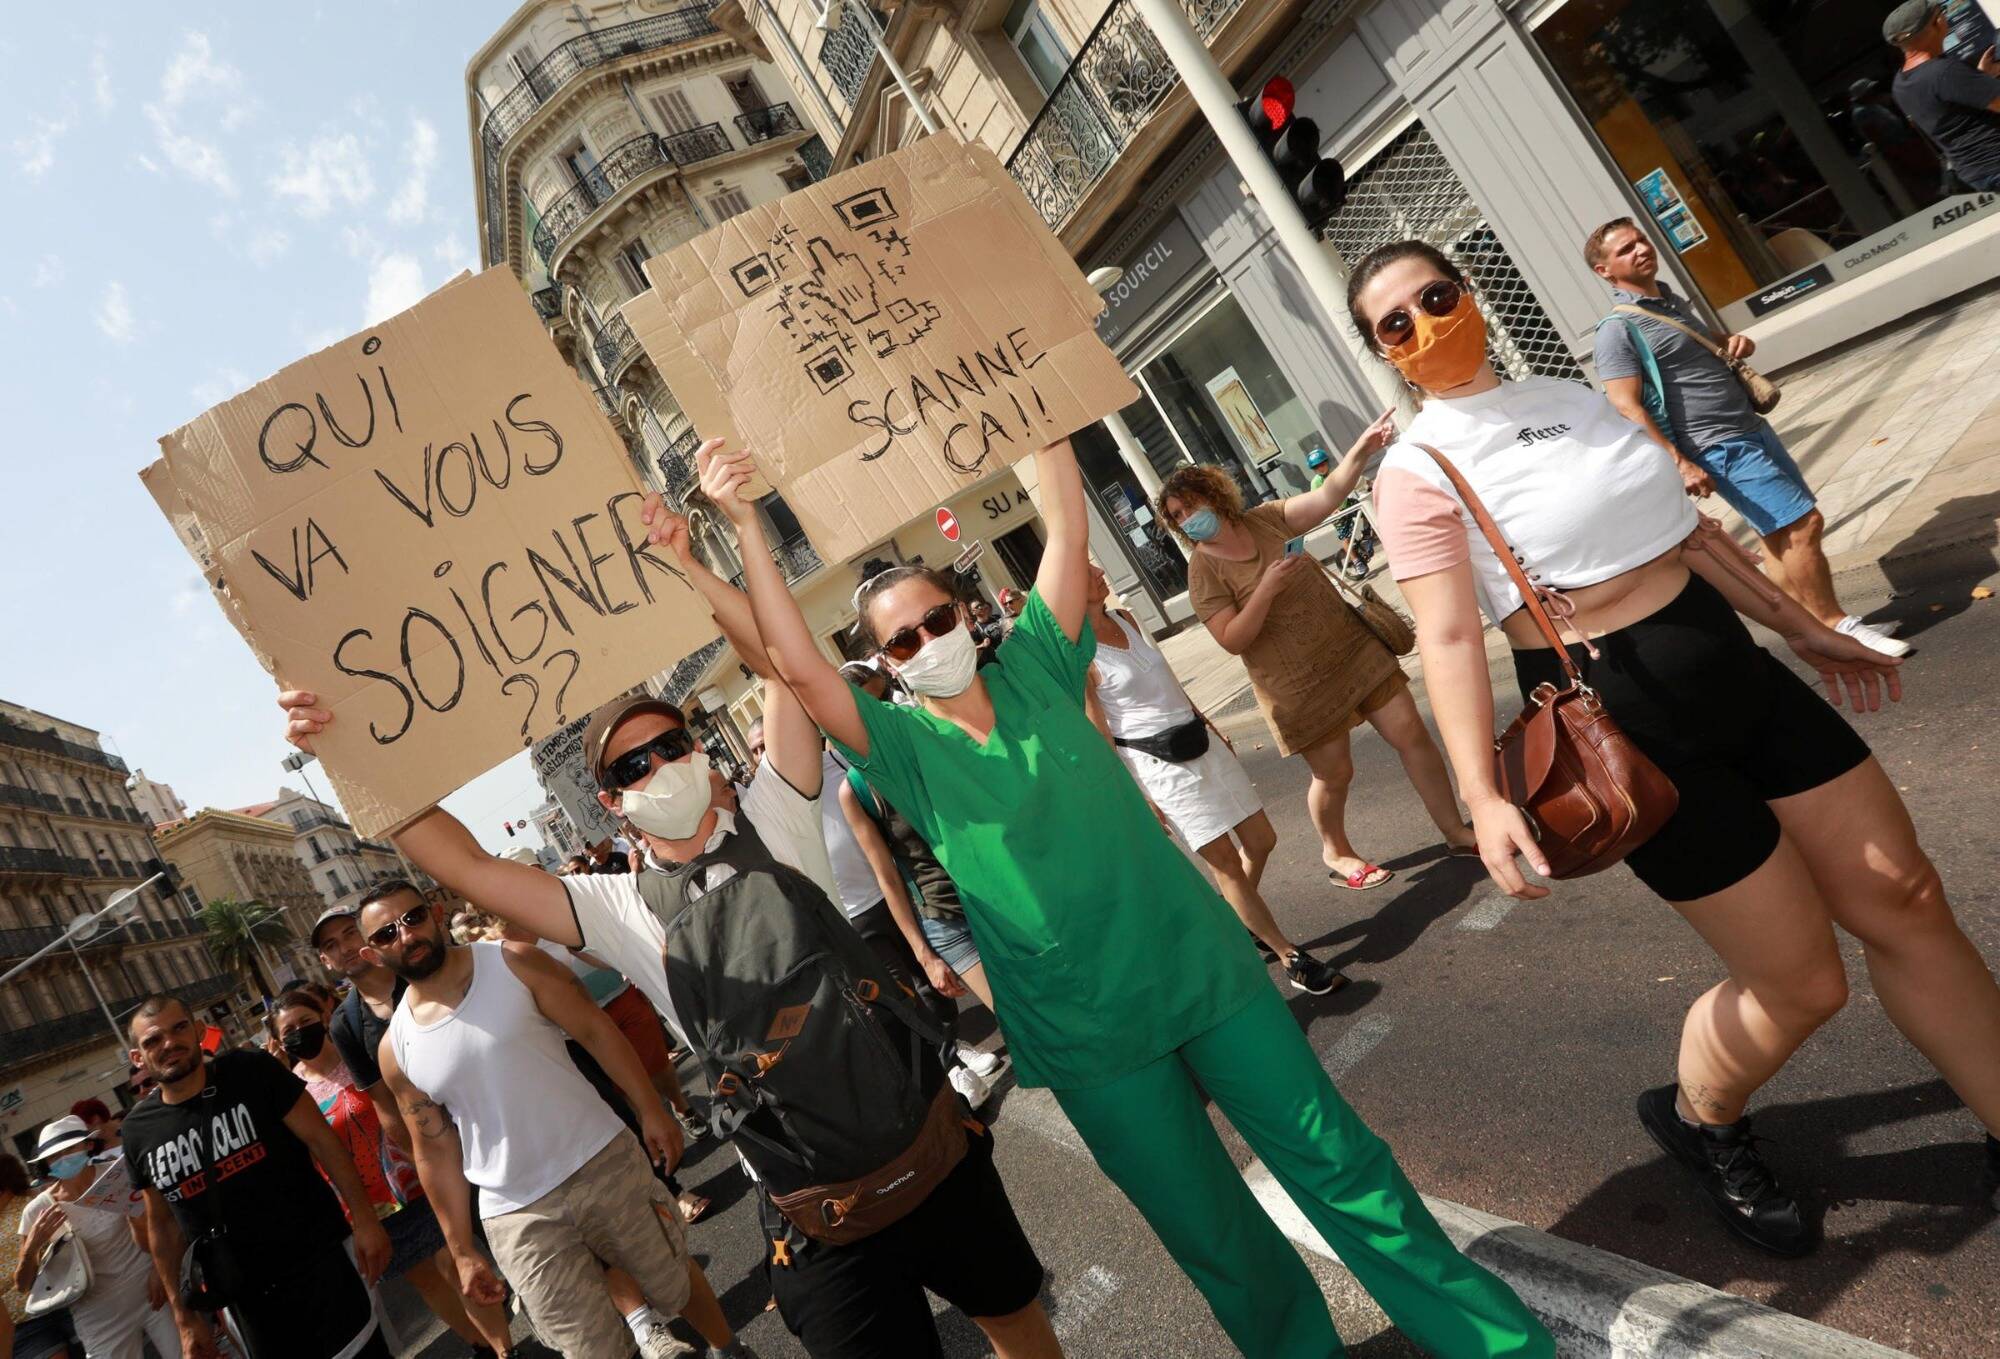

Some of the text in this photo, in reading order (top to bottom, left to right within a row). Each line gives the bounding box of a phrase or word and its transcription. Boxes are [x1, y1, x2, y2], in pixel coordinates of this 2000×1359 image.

[1932, 200, 1977, 230] ASIA
[1109, 241, 1174, 308] SOURCIL
[258, 336, 404, 474] QUI
[847, 326, 1048, 462] SCANNE
[1516, 423, 1572, 448] Fierce
[251, 393, 564, 602] VA VOUS
[983, 491, 1012, 519] SU
[333, 492, 695, 746] SOIGNER
[501, 649, 581, 747] ??
[541, 731, 568, 758] TEMPS
[147, 1103, 258, 1190] LEPANOLIN
